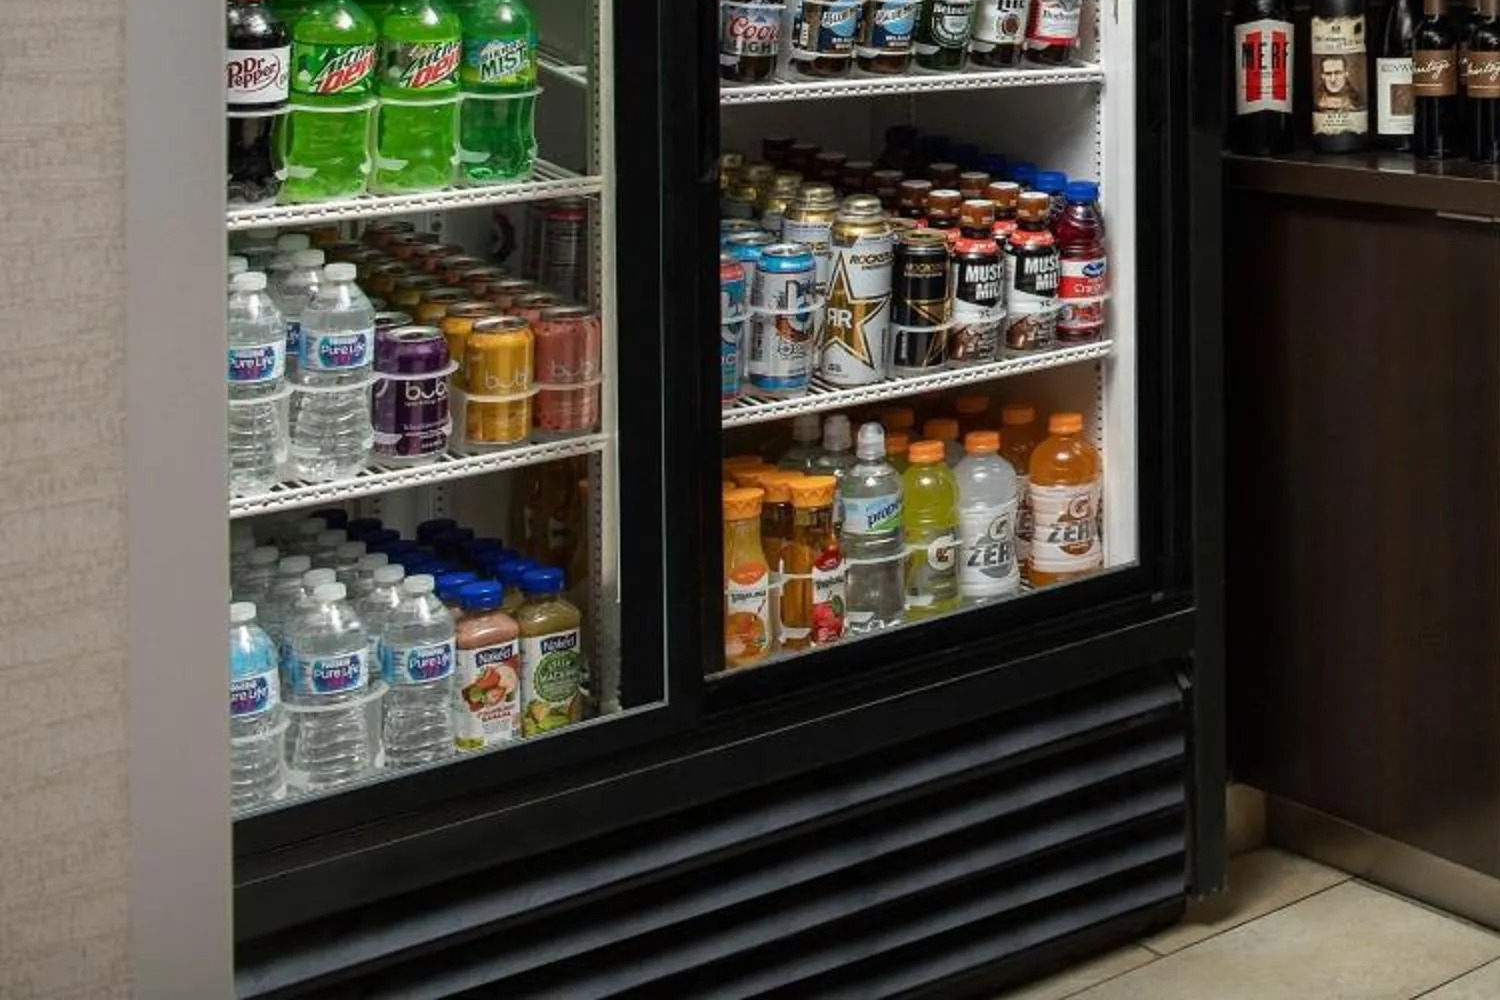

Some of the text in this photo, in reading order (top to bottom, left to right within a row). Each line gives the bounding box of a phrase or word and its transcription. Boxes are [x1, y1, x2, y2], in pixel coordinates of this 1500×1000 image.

[227, 62, 277, 89] Pepper
[244, 57, 265, 72] Dr
[1024, 256, 1058, 275] MUS
[1036, 274, 1058, 291] MIL
[405, 378, 449, 401] bub
[867, 501, 900, 529] prop
[1047, 519, 1092, 543] ZER
[966, 542, 1012, 568] ZER
